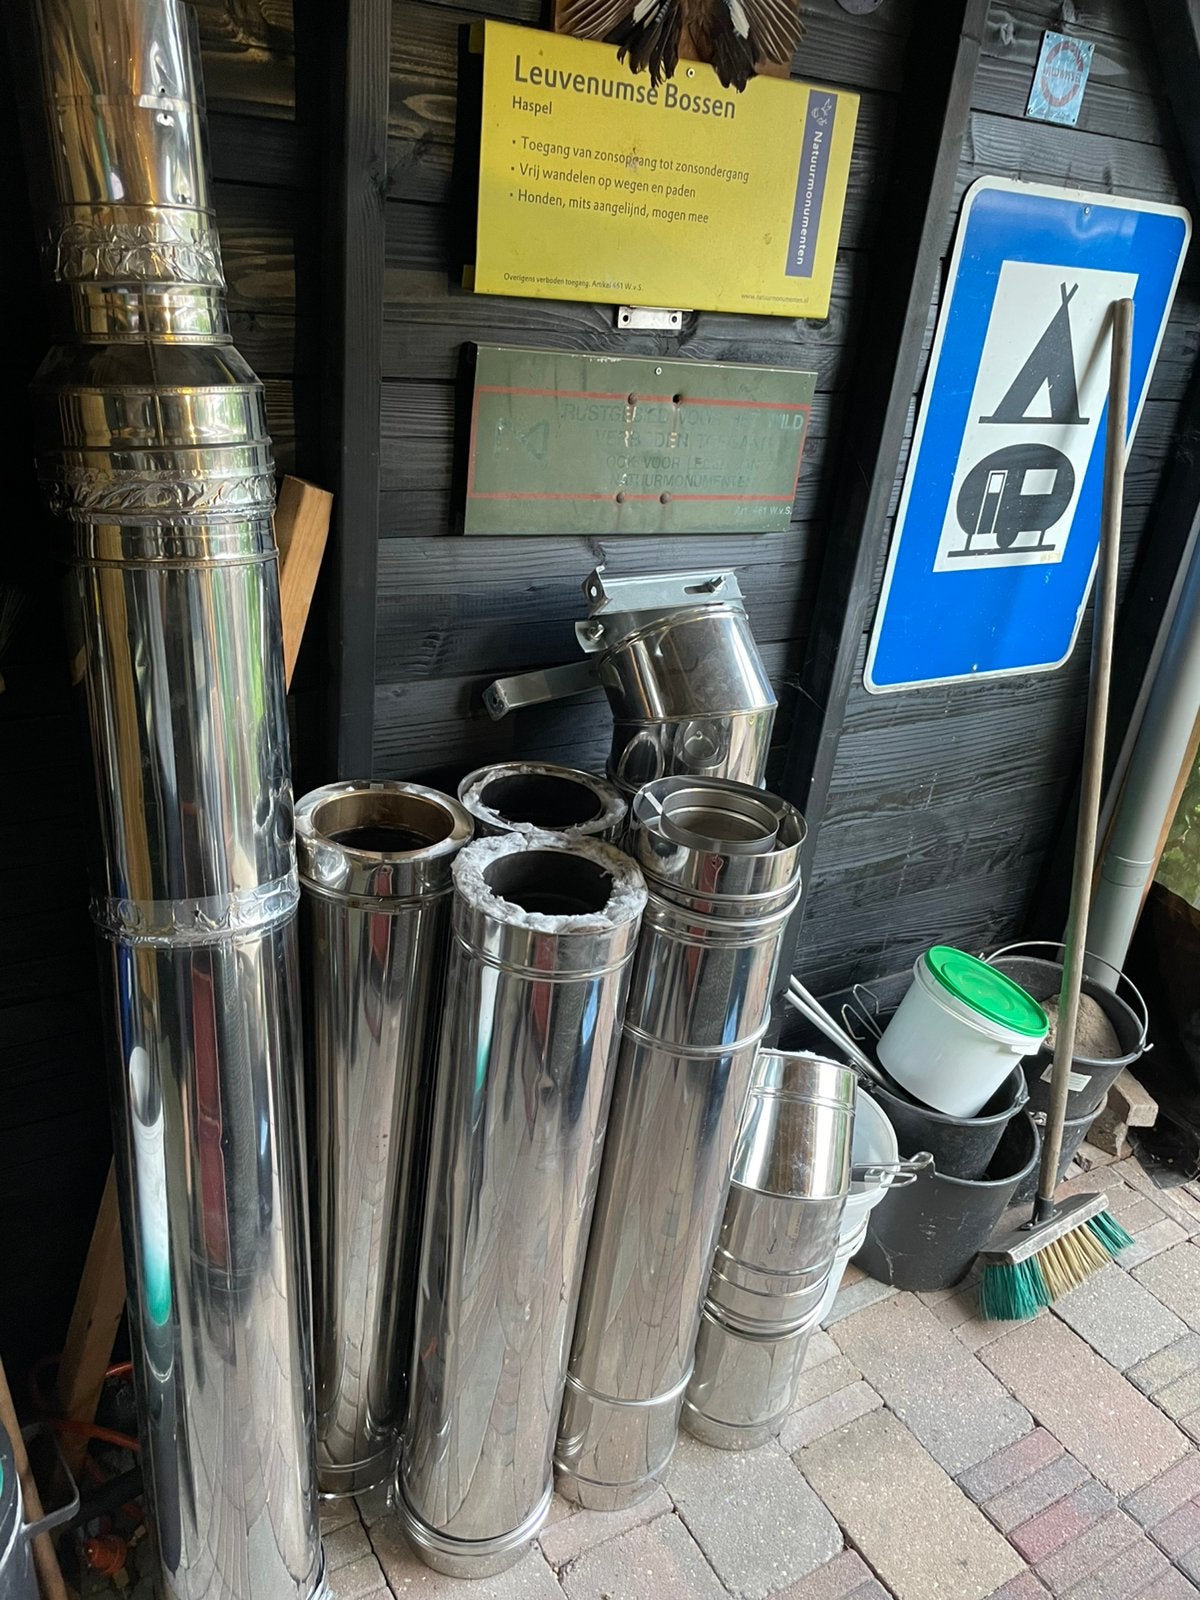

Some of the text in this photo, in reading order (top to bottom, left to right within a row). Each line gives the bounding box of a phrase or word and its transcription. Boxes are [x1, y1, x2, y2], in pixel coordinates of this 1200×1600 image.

[514, 54, 736, 120] Leuvenumse Bossen
[512, 95, 553, 117] Haspel
[521, 135, 750, 185] Toegang van zonsopgang tot zonsondergang
[519, 162, 697, 198] Vrij wandelen op wegen en paden
[796, 130, 824, 266] Natuurmonumenten
[518, 188, 709, 224] Honden, mits aangelijnd, mogen mee
[503, 272, 535, 284] Overigens
[536, 275, 565, 286] verboden
